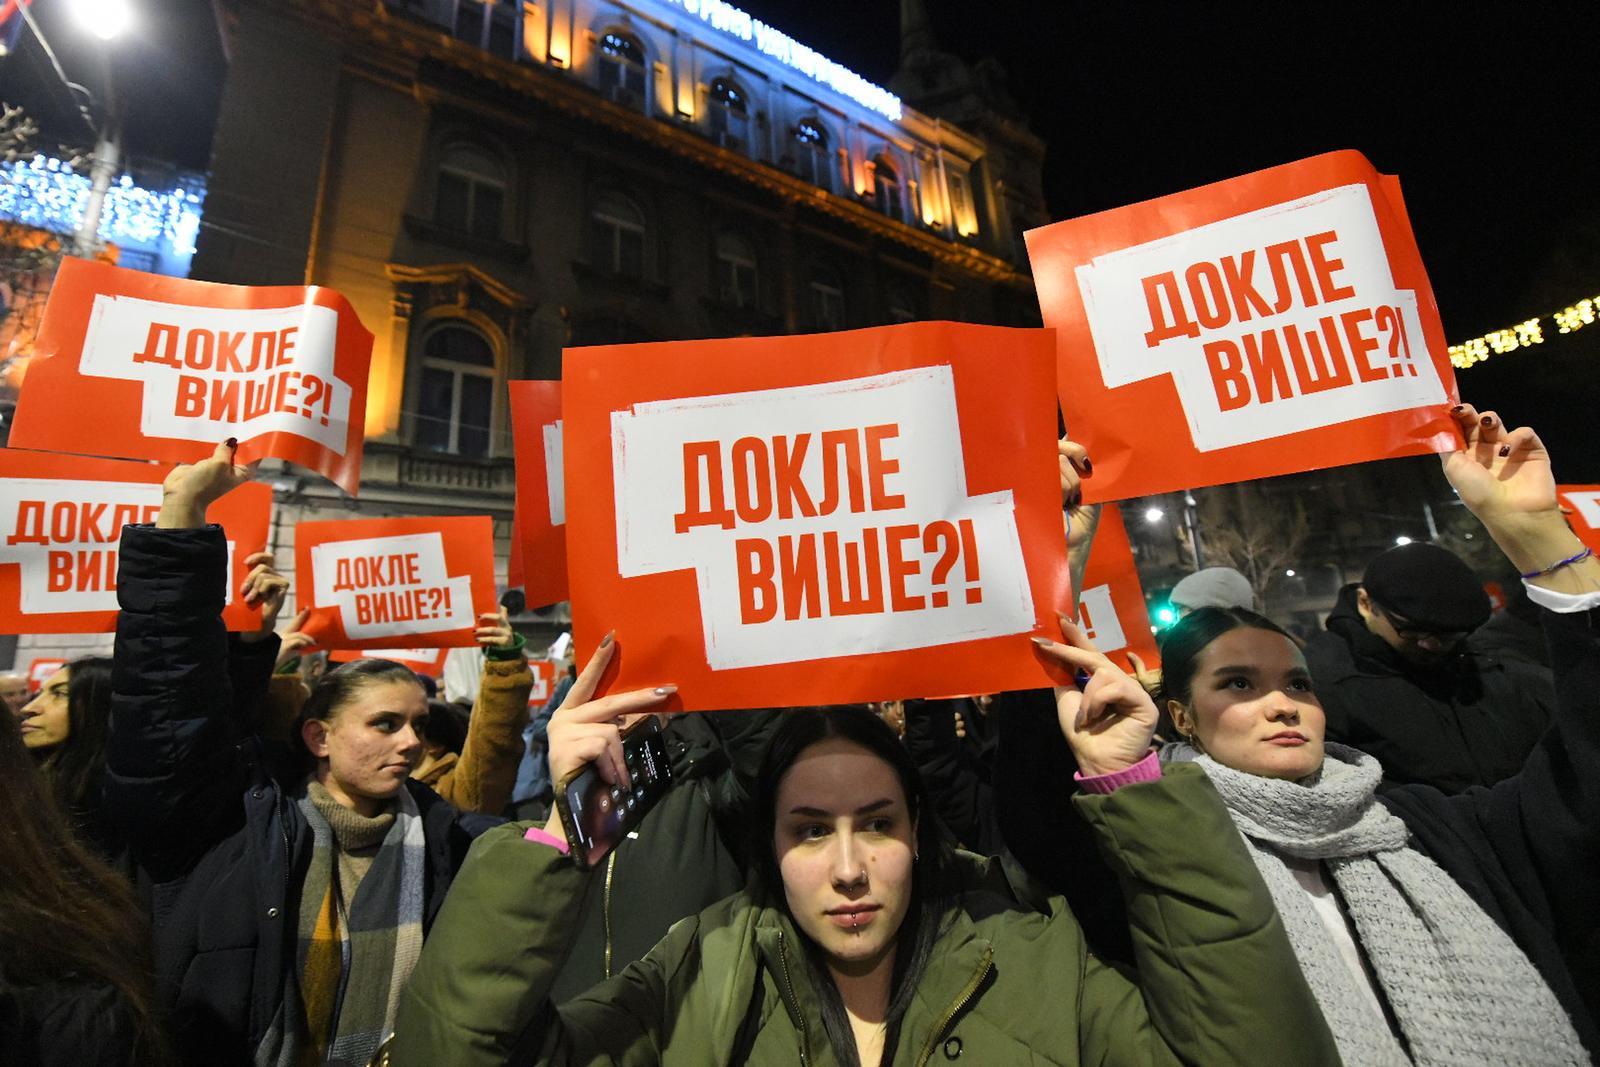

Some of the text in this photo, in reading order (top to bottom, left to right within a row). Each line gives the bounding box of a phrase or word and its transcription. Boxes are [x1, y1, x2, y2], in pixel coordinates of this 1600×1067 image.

[1142, 230, 1357, 348] ДОКЛЕ
[133, 322, 299, 373] ДОКЛЕ
[1203, 305, 1419, 412] ВИШЕ?!
[174, 371, 332, 428] ВИШЕ?!
[674, 423, 906, 534] ДОКЛЕ
[333, 553, 421, 593] ДОКЛЕ
[355, 585, 453, 625] ВИШЕ?!
[735, 519, 983, 625] ВИШЕ?!
